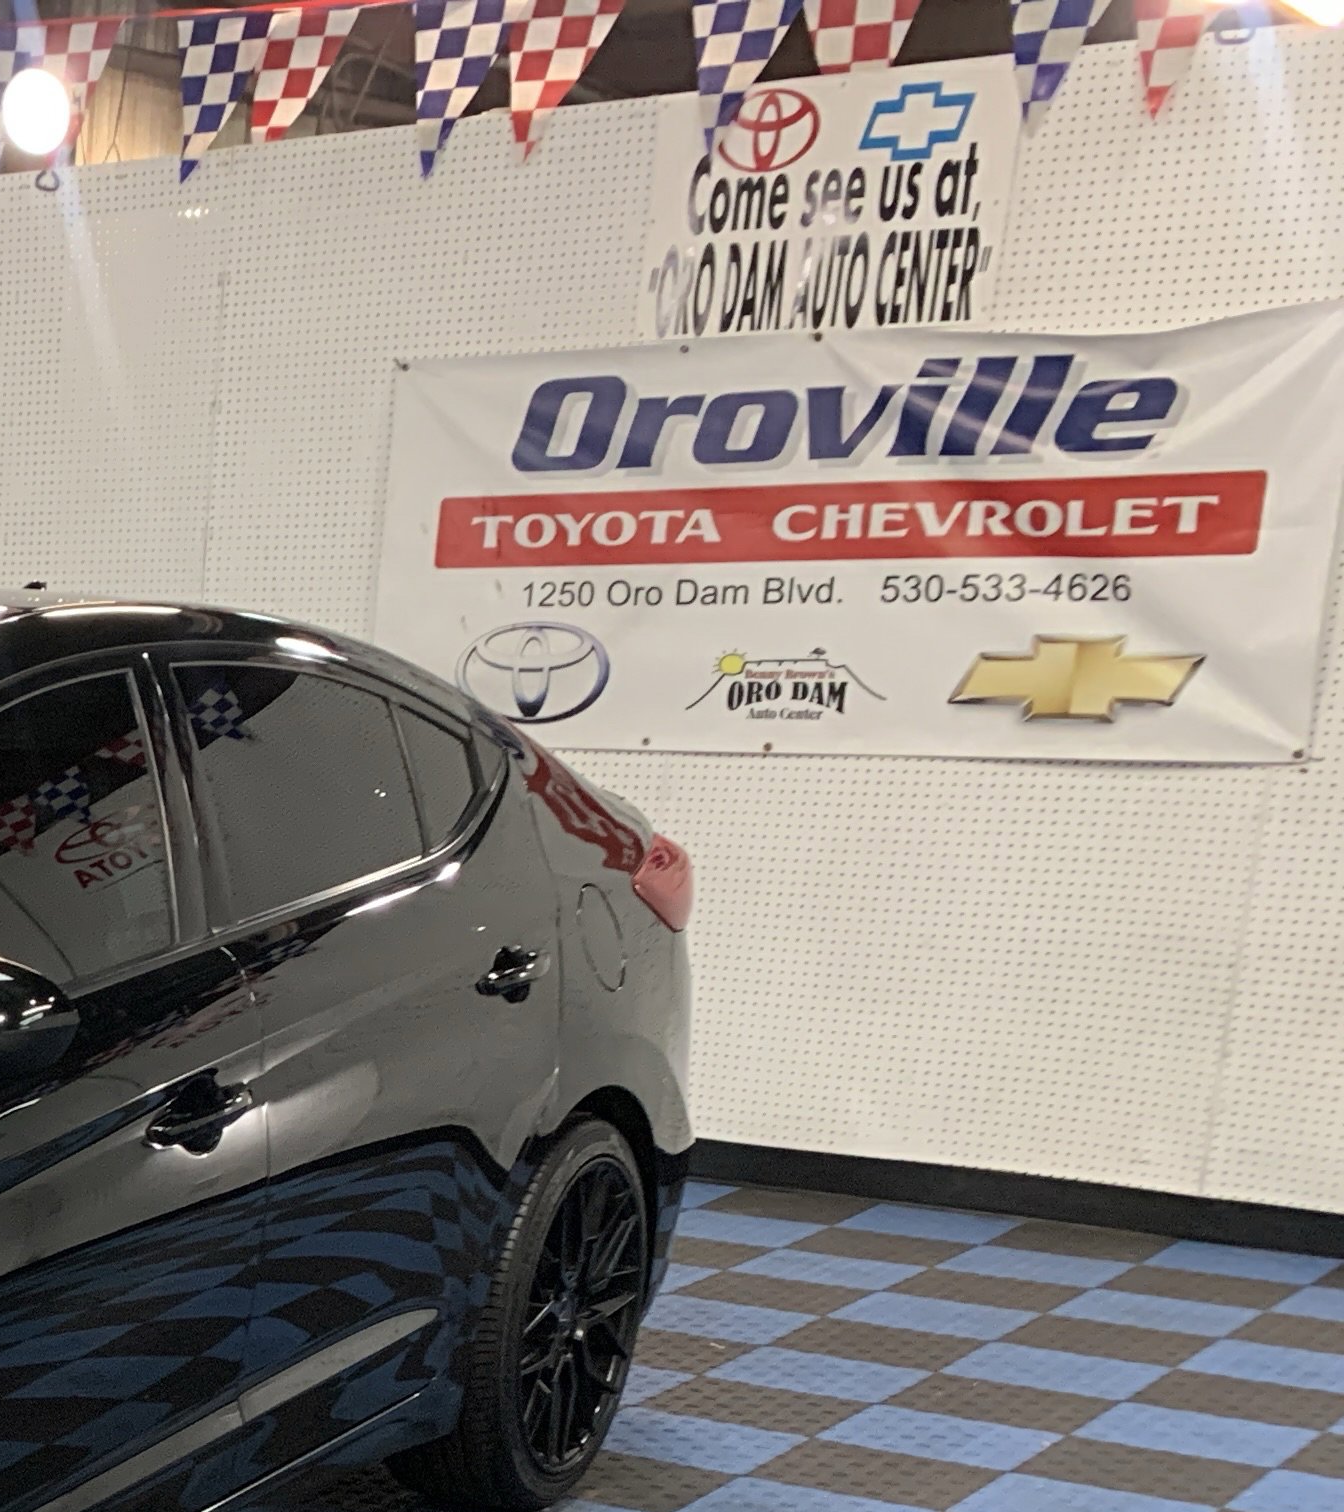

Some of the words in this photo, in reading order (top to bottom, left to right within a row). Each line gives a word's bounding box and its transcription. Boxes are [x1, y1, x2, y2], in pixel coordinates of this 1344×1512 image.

[688, 154, 789, 235] Come
[800, 166, 867, 228] see
[879, 161, 924, 222] us
[935, 142, 980, 222] at,
[719, 239, 788, 333] DAM
[789, 231, 870, 330] AUTO
[875, 227, 993, 327] CENTER"
[511, 354, 1181, 474] Oroville
[471, 508, 722, 549] TOYOTA
[771, 495, 1220, 541] CHEVROLET
[522, 579, 595, 608] 1250
[606, 578, 663, 607] Oro
[675, 577, 749, 606] Dam
[763, 575, 844, 605] Blvd.
[880, 572, 1132, 604] 530-533-4626
[726, 680, 782, 711] ORO
[791, 681, 848, 714] DAM
[746, 707, 777, 720] Auto
[779, 707, 823, 720] Center
